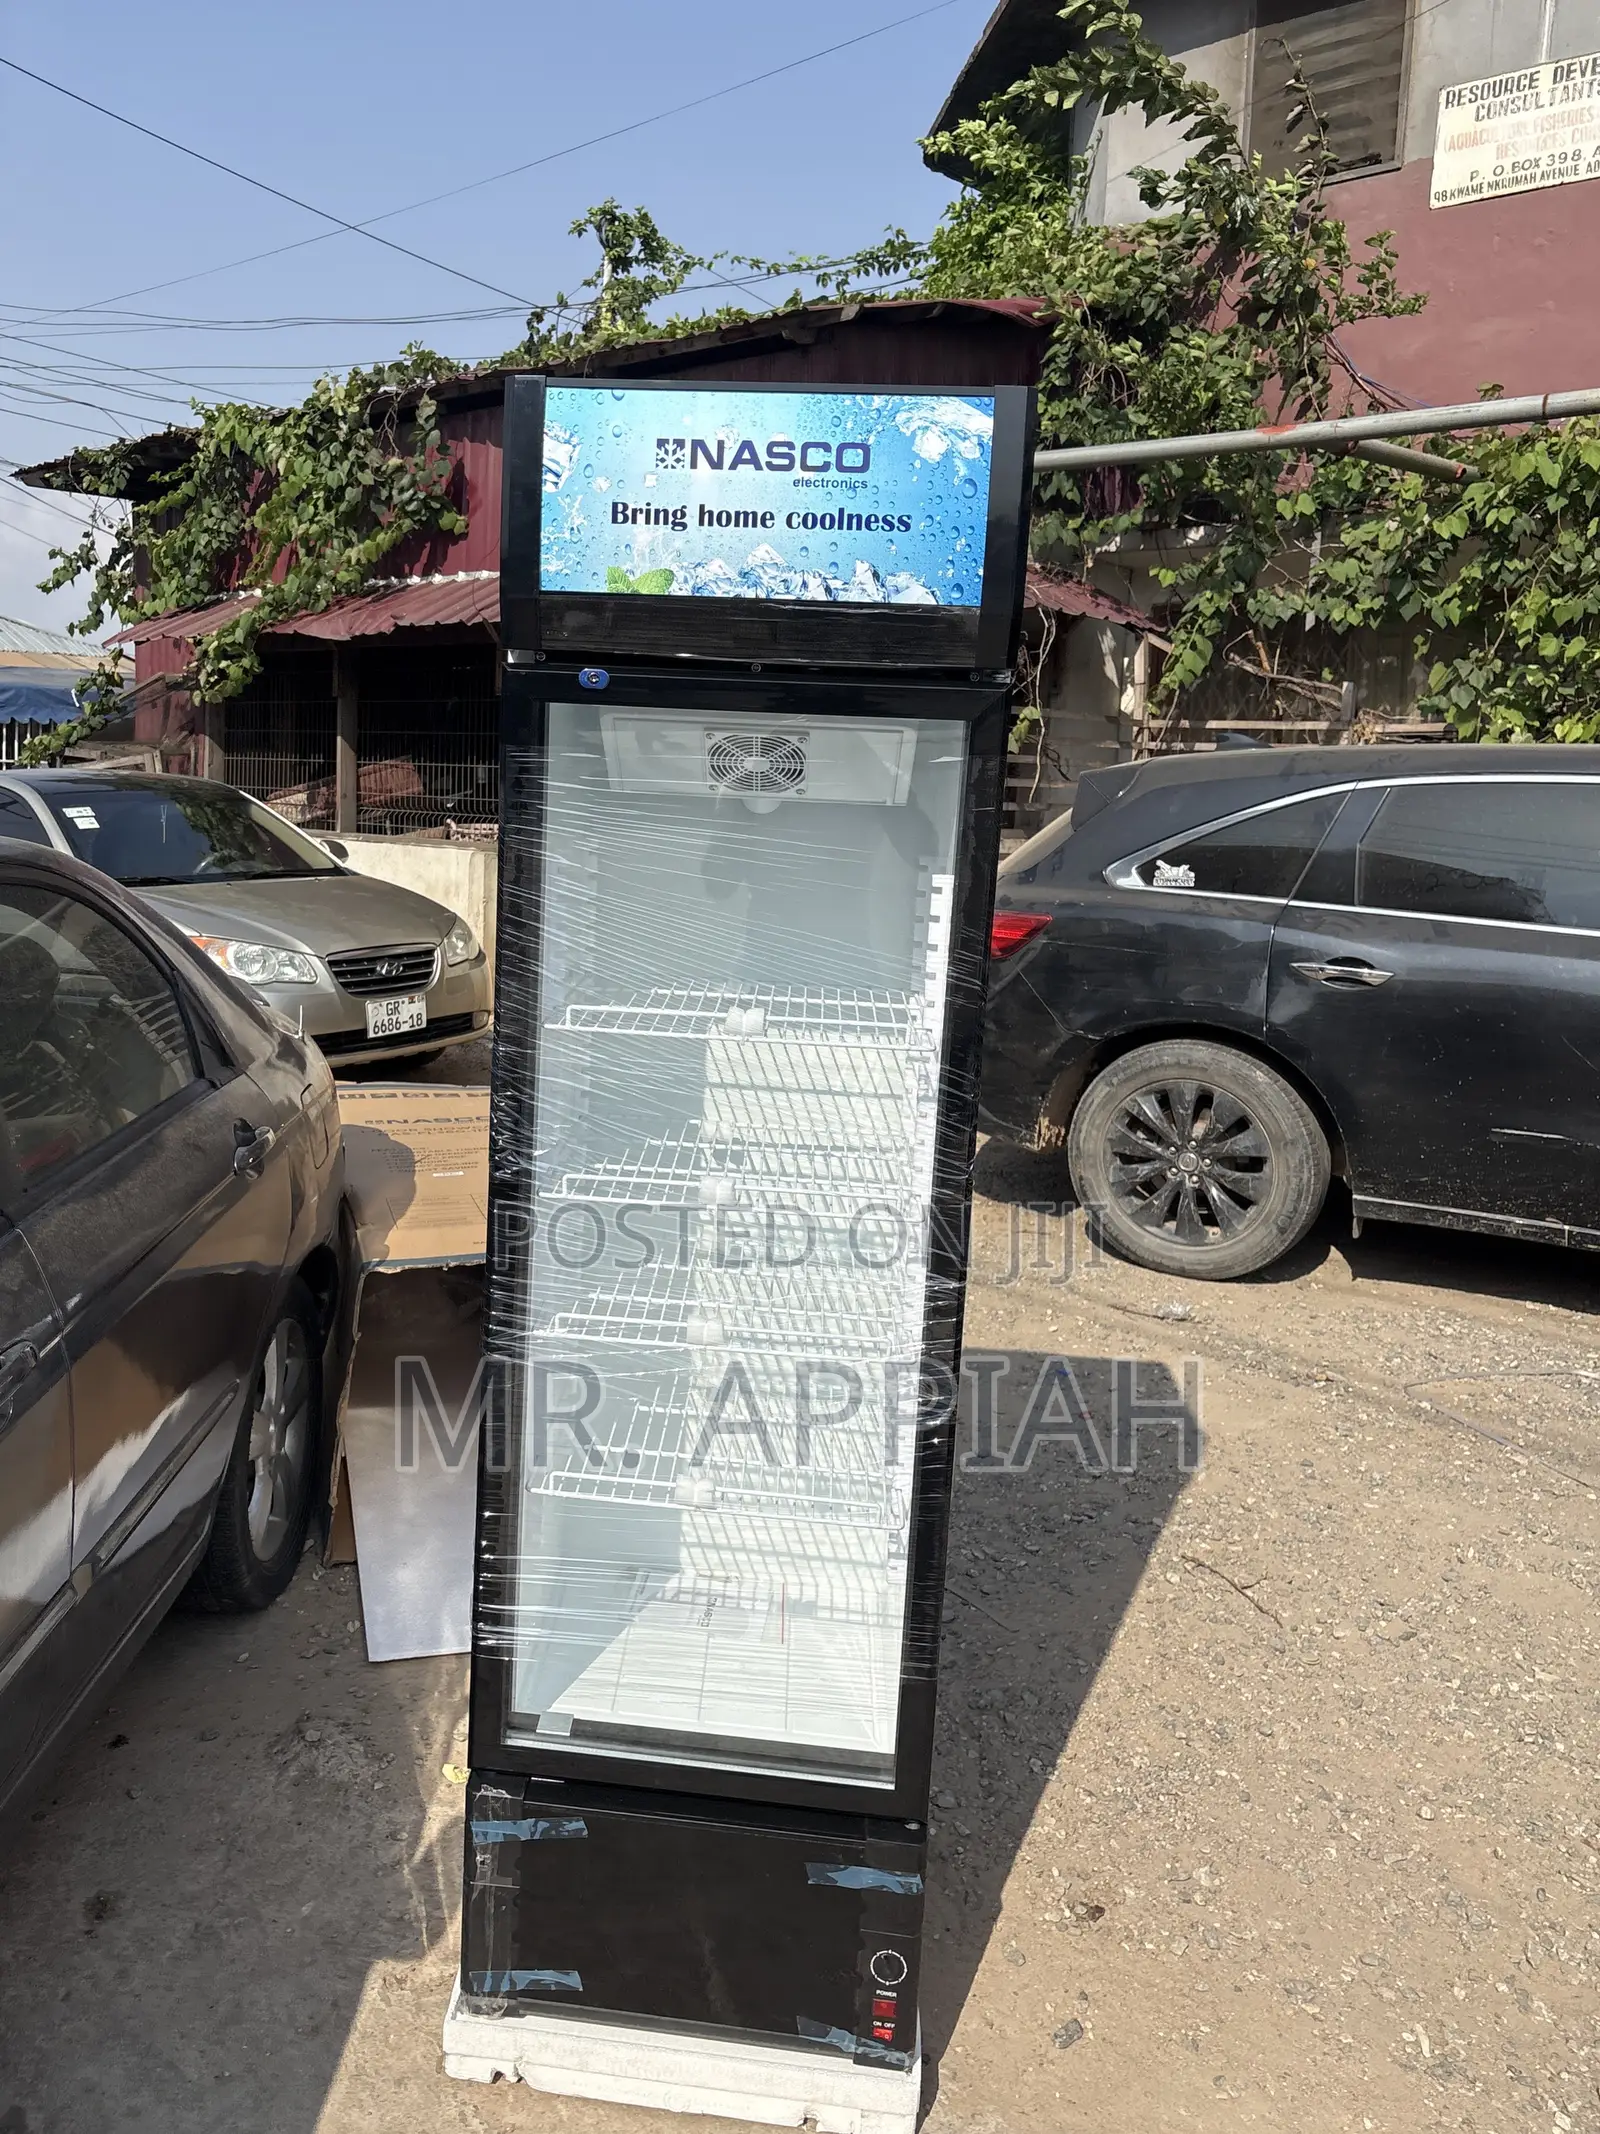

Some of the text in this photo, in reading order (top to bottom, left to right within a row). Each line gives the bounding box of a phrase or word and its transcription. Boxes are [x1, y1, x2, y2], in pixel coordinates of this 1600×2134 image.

[1445, 70, 1541, 110] RESOURCE
[1434, 189, 1449, 203] 98
[1449, 182, 1485, 201] KWAME
[1486, 171, 1537, 194] NKRUMAH
[1539, 163, 1581, 183] AVENUE
[690, 438, 871, 474] NASCO
[792, 476, 869, 490] electronics
[611, 501, 914, 533] Bring home coolness
[372, 1012, 423, 1035] 6686-18
[386, 1000, 401, 1017] GR
